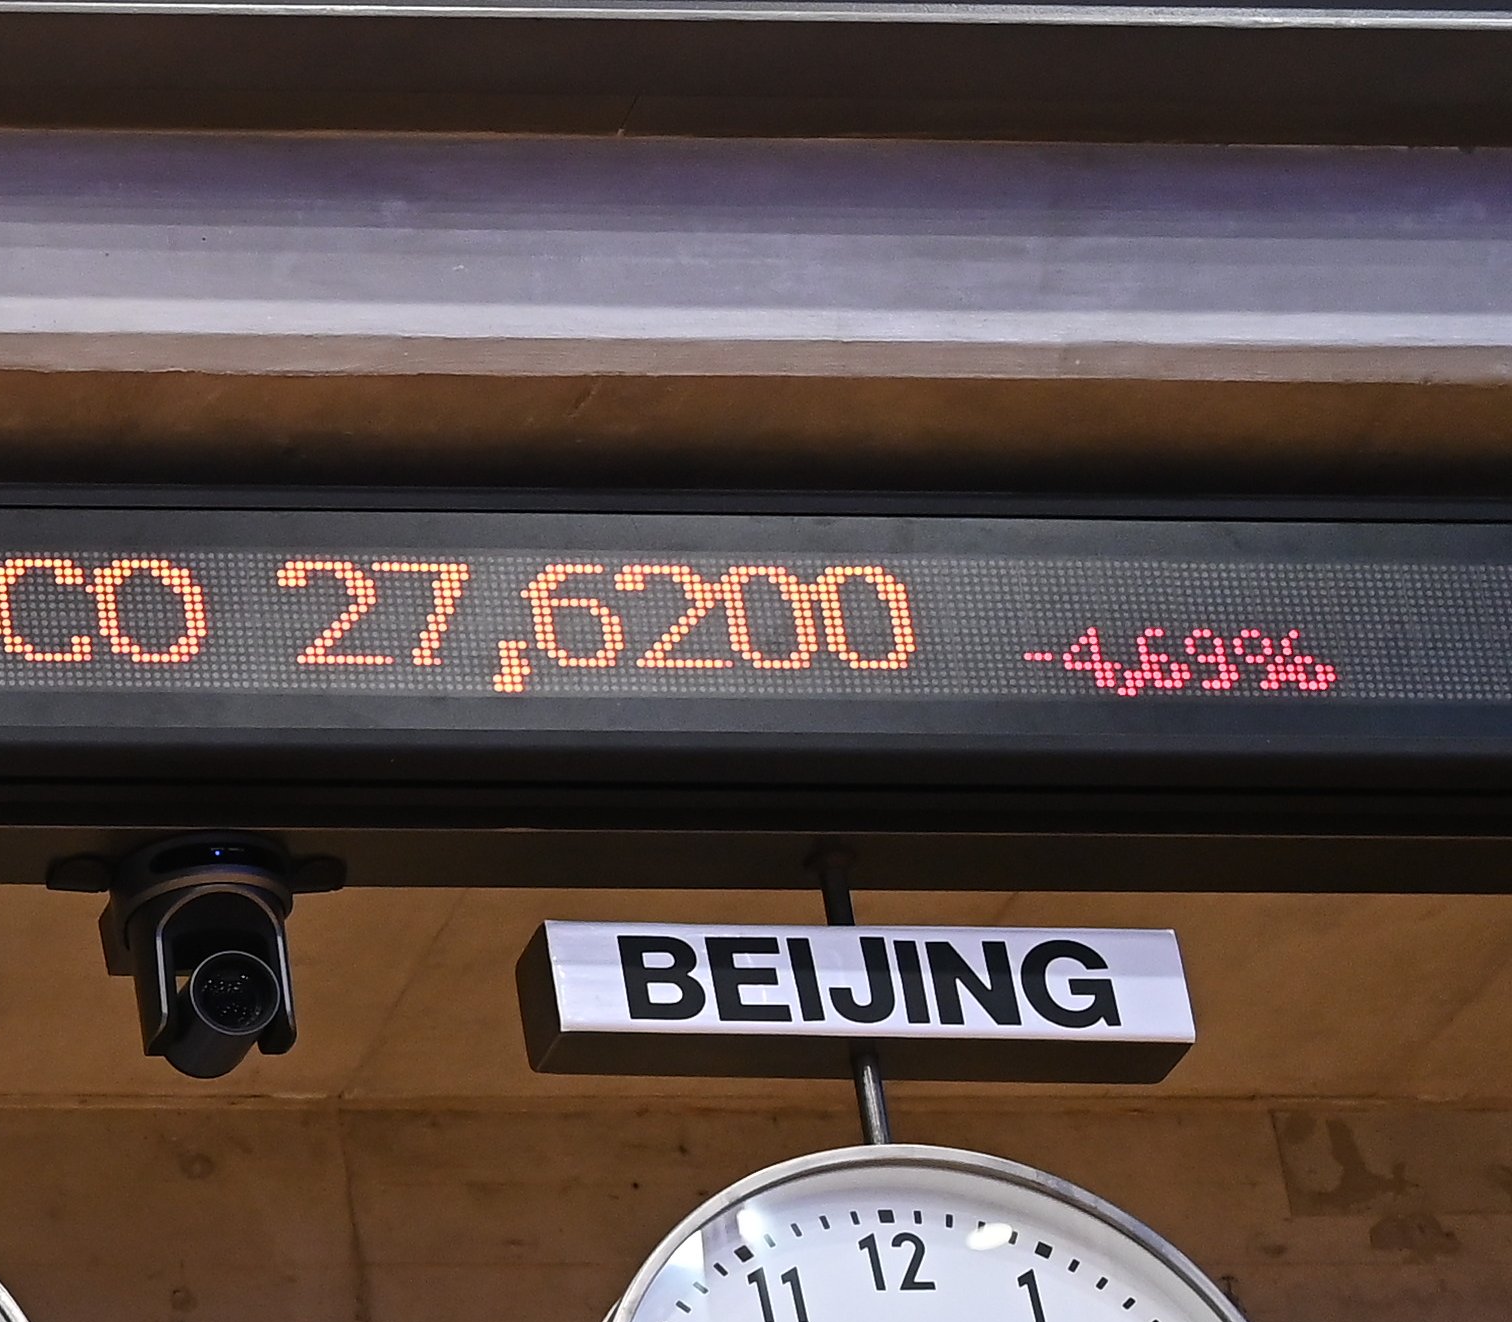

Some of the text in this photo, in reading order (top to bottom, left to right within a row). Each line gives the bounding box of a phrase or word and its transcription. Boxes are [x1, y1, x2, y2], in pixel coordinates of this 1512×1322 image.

[281, 561, 918, 693] 27,6200
[1027, 627, 1336, 696] -4,69%
[617, 936, 1121, 1028] BEIJING
[858, 1232, 936, 1291] 12
